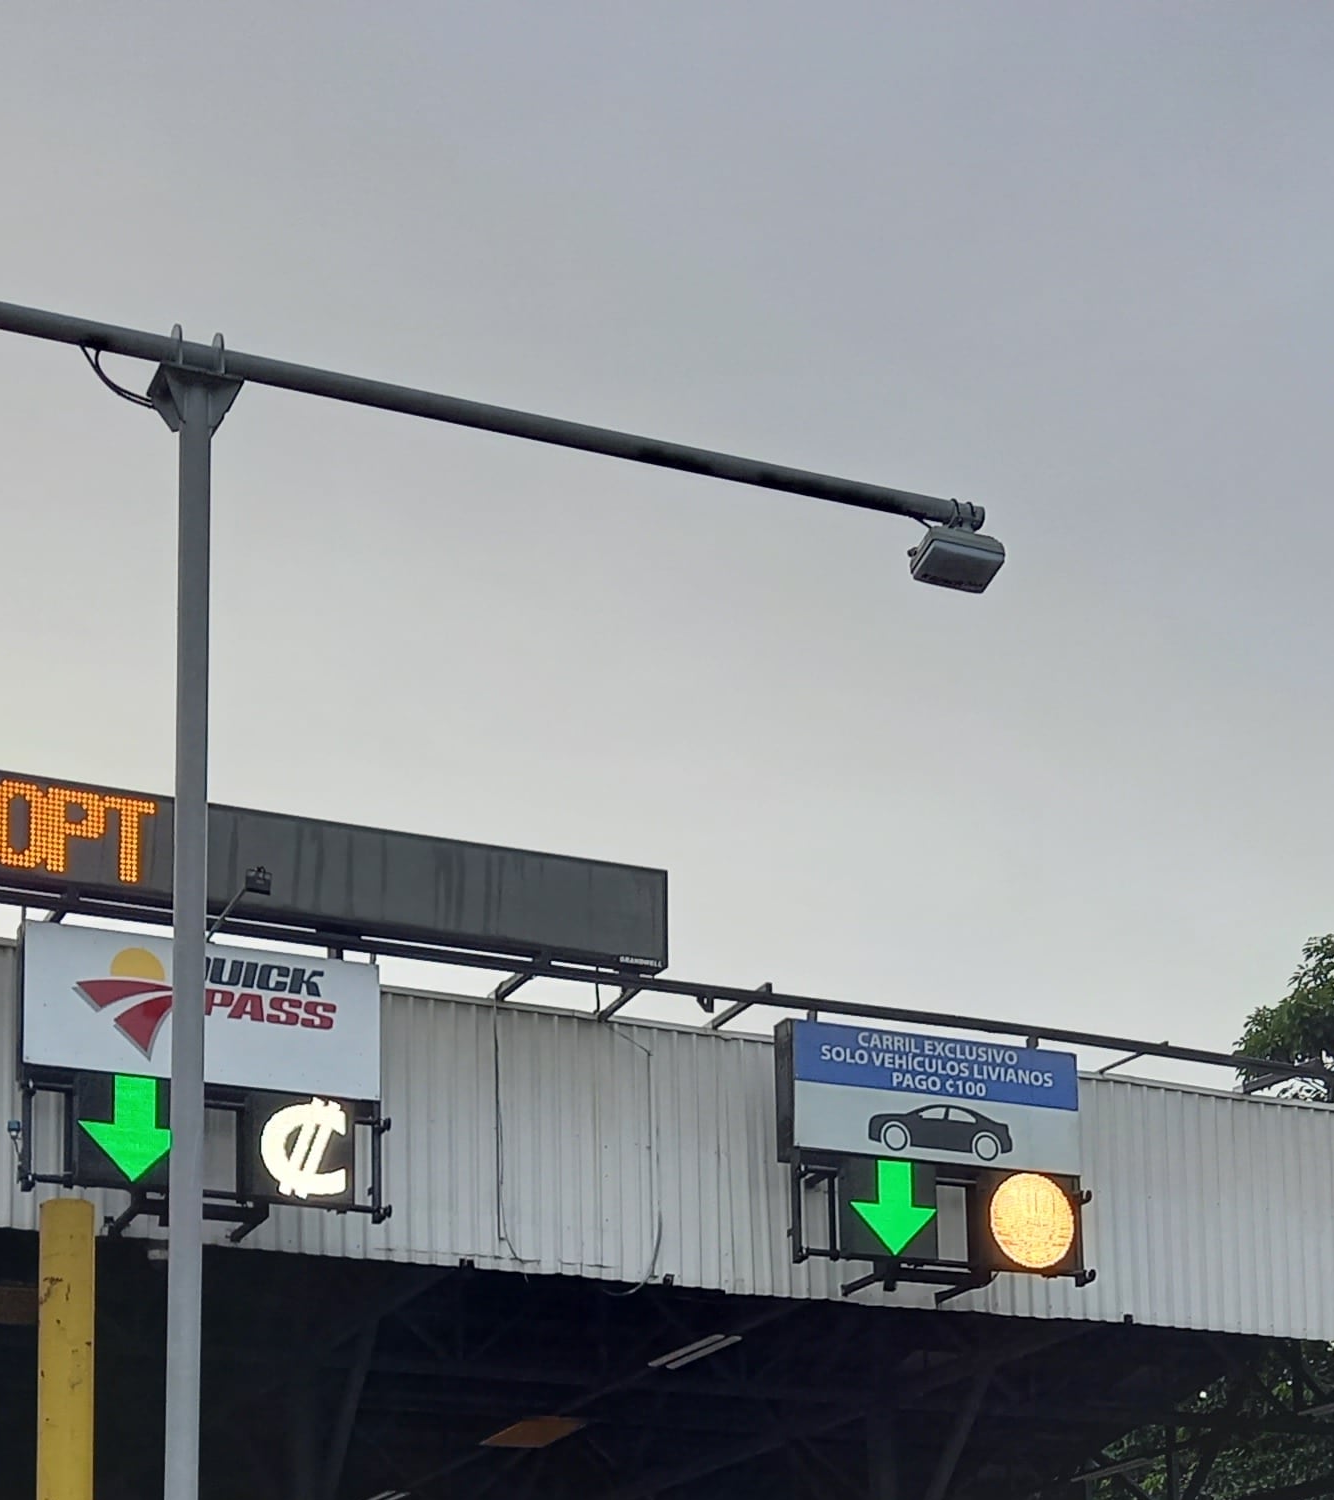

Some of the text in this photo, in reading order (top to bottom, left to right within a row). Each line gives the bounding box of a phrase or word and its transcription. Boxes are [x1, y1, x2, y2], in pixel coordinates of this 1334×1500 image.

[205, 957, 324, 997] UICK
[205, 988, 337, 1030] PASS
[820, 1044, 1054, 1088] SOLO VEHÍCULOS LIVIANOS
[857, 1031, 1018, 1066] CARRIL EXCLUSIVO
[892, 1071, 941, 1092] PAGO
